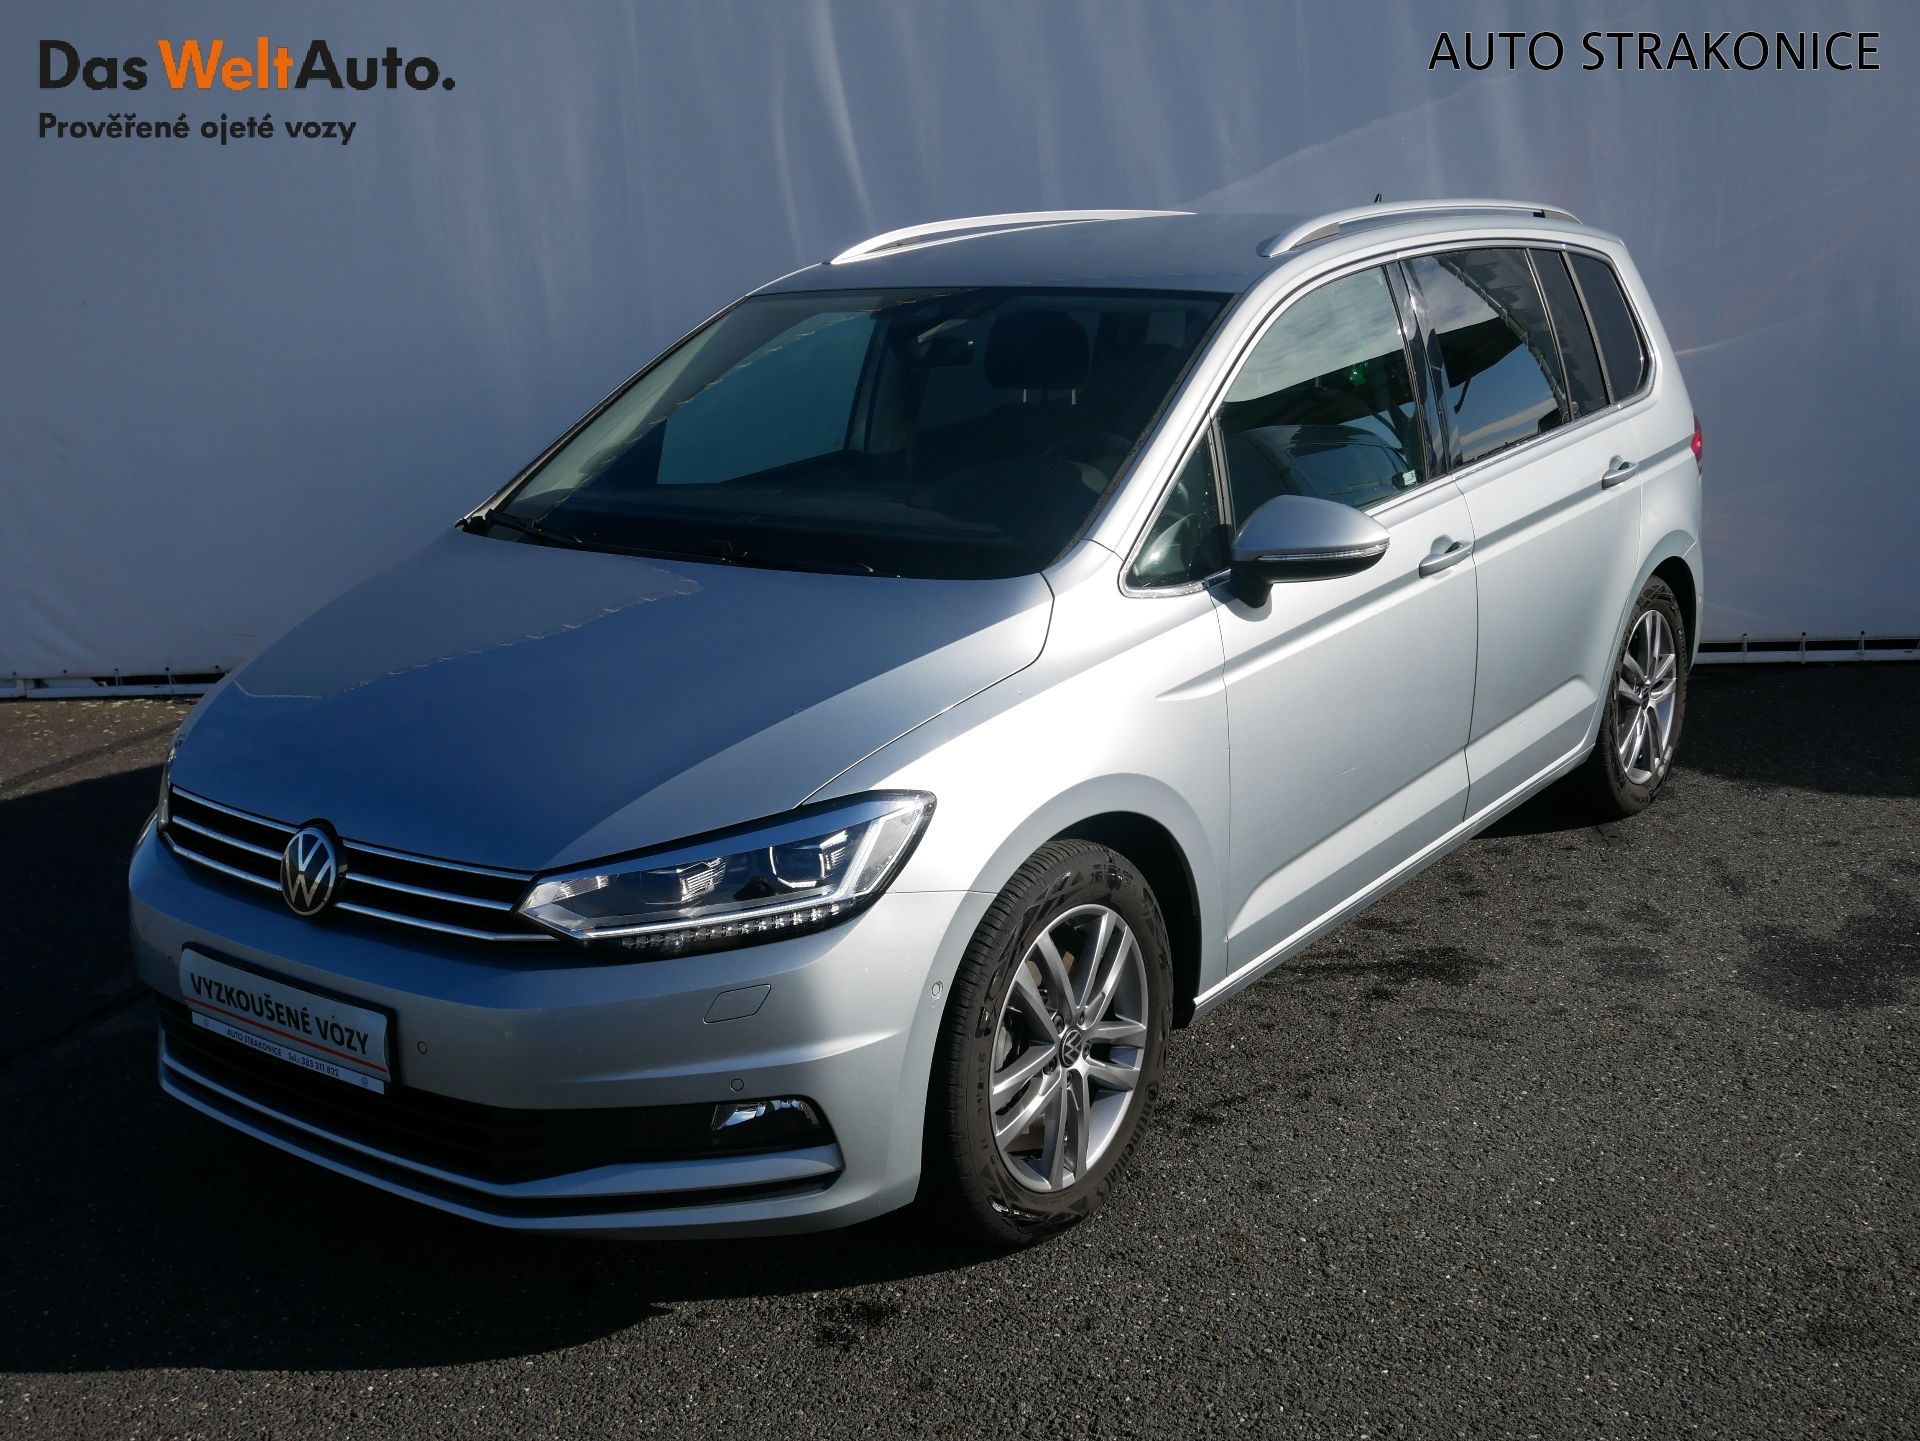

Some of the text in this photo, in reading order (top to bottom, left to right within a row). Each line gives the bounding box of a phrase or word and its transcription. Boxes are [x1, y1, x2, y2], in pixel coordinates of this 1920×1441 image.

[190, 973, 369, 1055] VYZKOUŠENÉ VOZY
[227, 1028, 243, 1041] AUTO
[244, 1035, 282, 1056] STRAKONICE
[327, 1066, 339, 1077] 822
